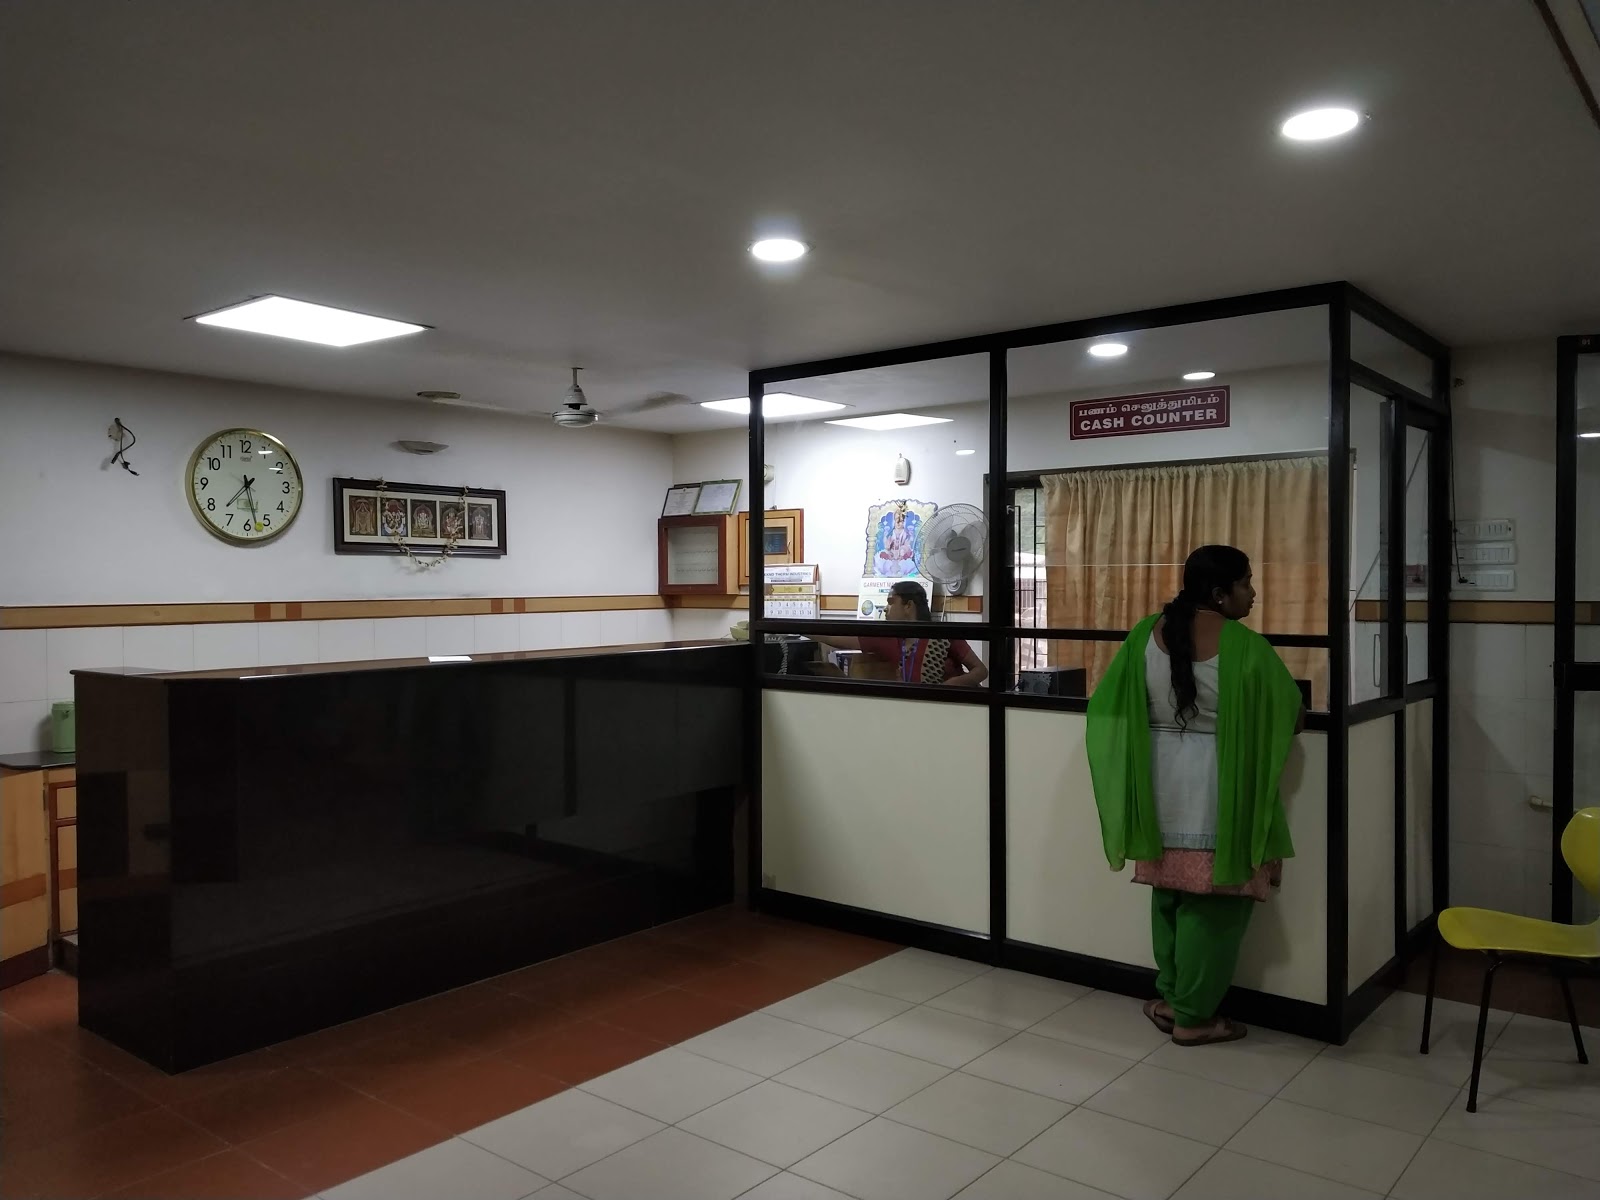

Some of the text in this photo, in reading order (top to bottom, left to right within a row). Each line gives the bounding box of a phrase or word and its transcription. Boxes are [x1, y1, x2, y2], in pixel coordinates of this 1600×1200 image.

[1078, 394, 1220, 416] பணம் செலுத்துமிடம்
[1080, 408, 1217, 431] CASH COUNTER
[220, 444, 232, 458] 11
[240, 440, 252, 454] 12
[207, 457, 221, 471] 10
[275, 461, 284, 474] 2
[200, 477, 208, 490] 9
[282, 481, 290, 494] 3
[207, 498, 216, 511] 8
[276, 500, 285, 512] 4
[226, 514, 234, 526] 7
[244, 519, 251, 531] 6
[263, 514, 271, 526] 5
